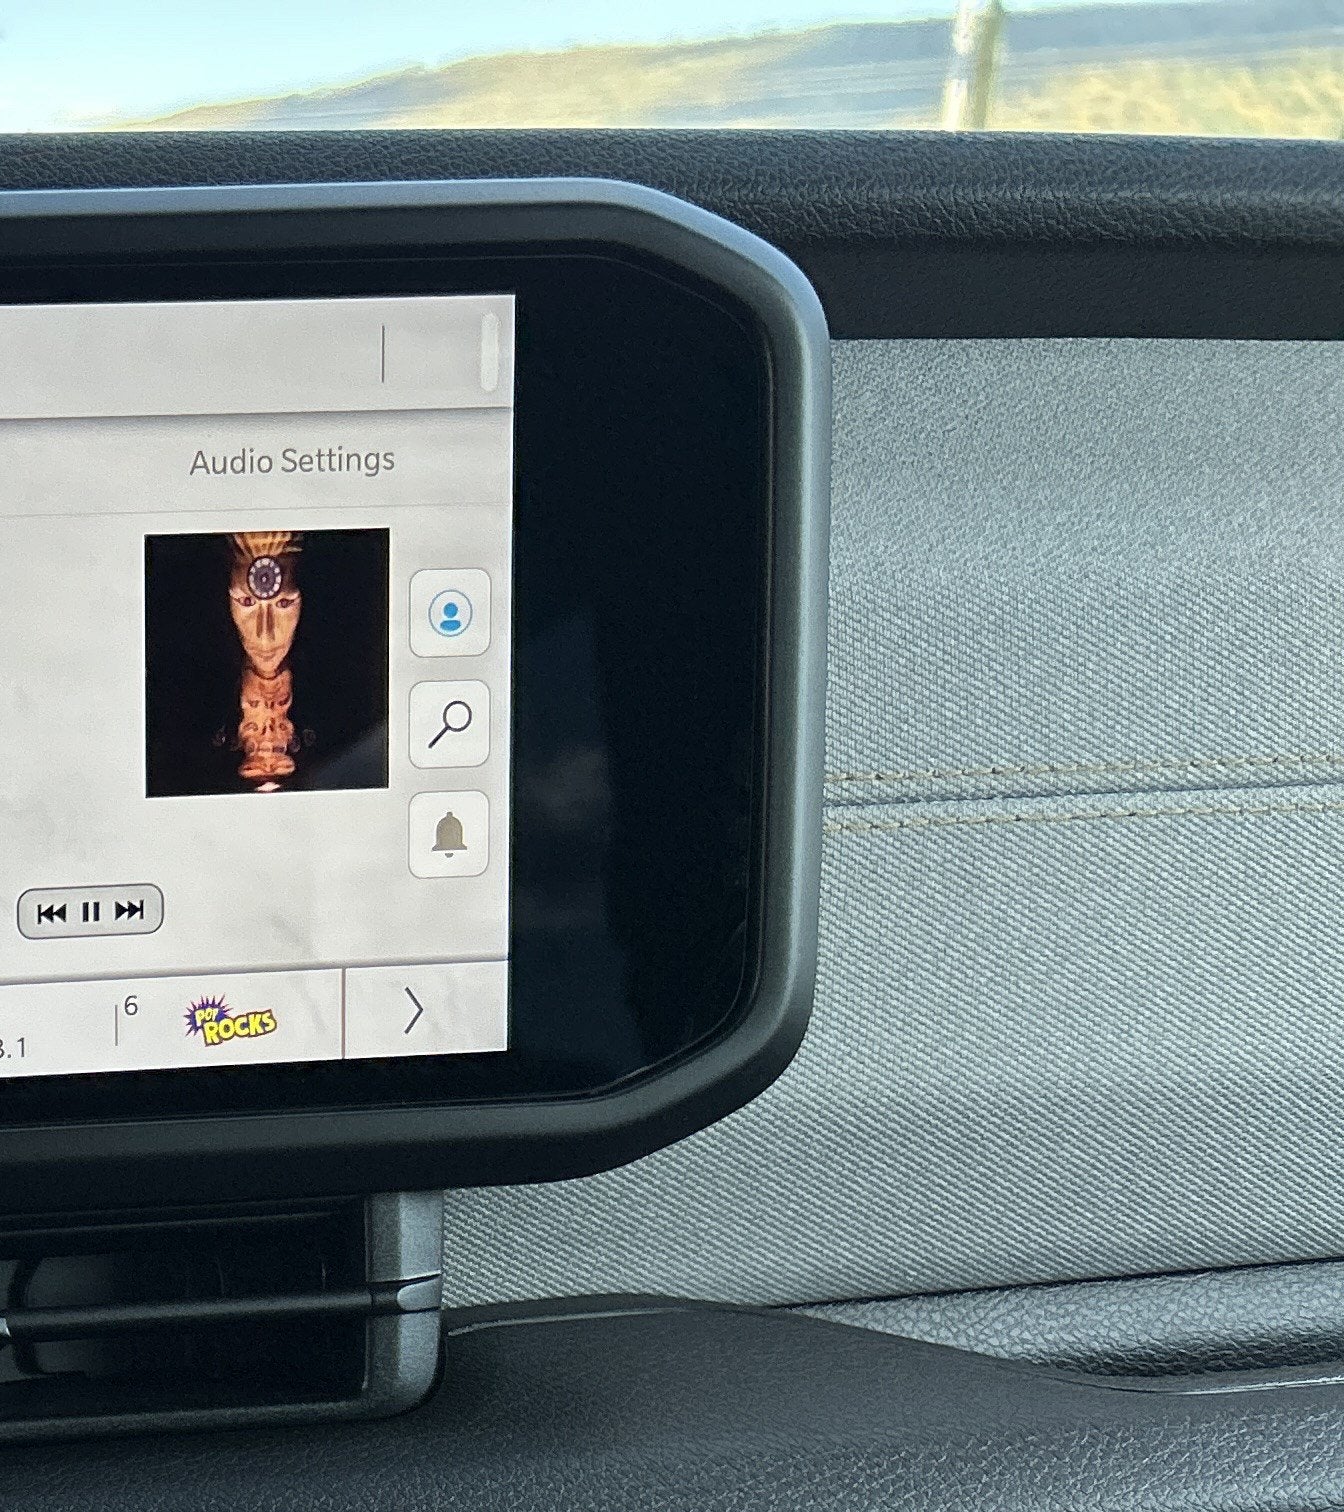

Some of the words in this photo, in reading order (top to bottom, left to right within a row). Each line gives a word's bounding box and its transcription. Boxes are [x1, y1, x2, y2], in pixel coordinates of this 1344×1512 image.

[190, 449, 273, 476] Audio
[281, 446, 395, 479] Settings
[124, 996, 139, 1017] 6
[203, 1012, 276, 1044] ROCKS
